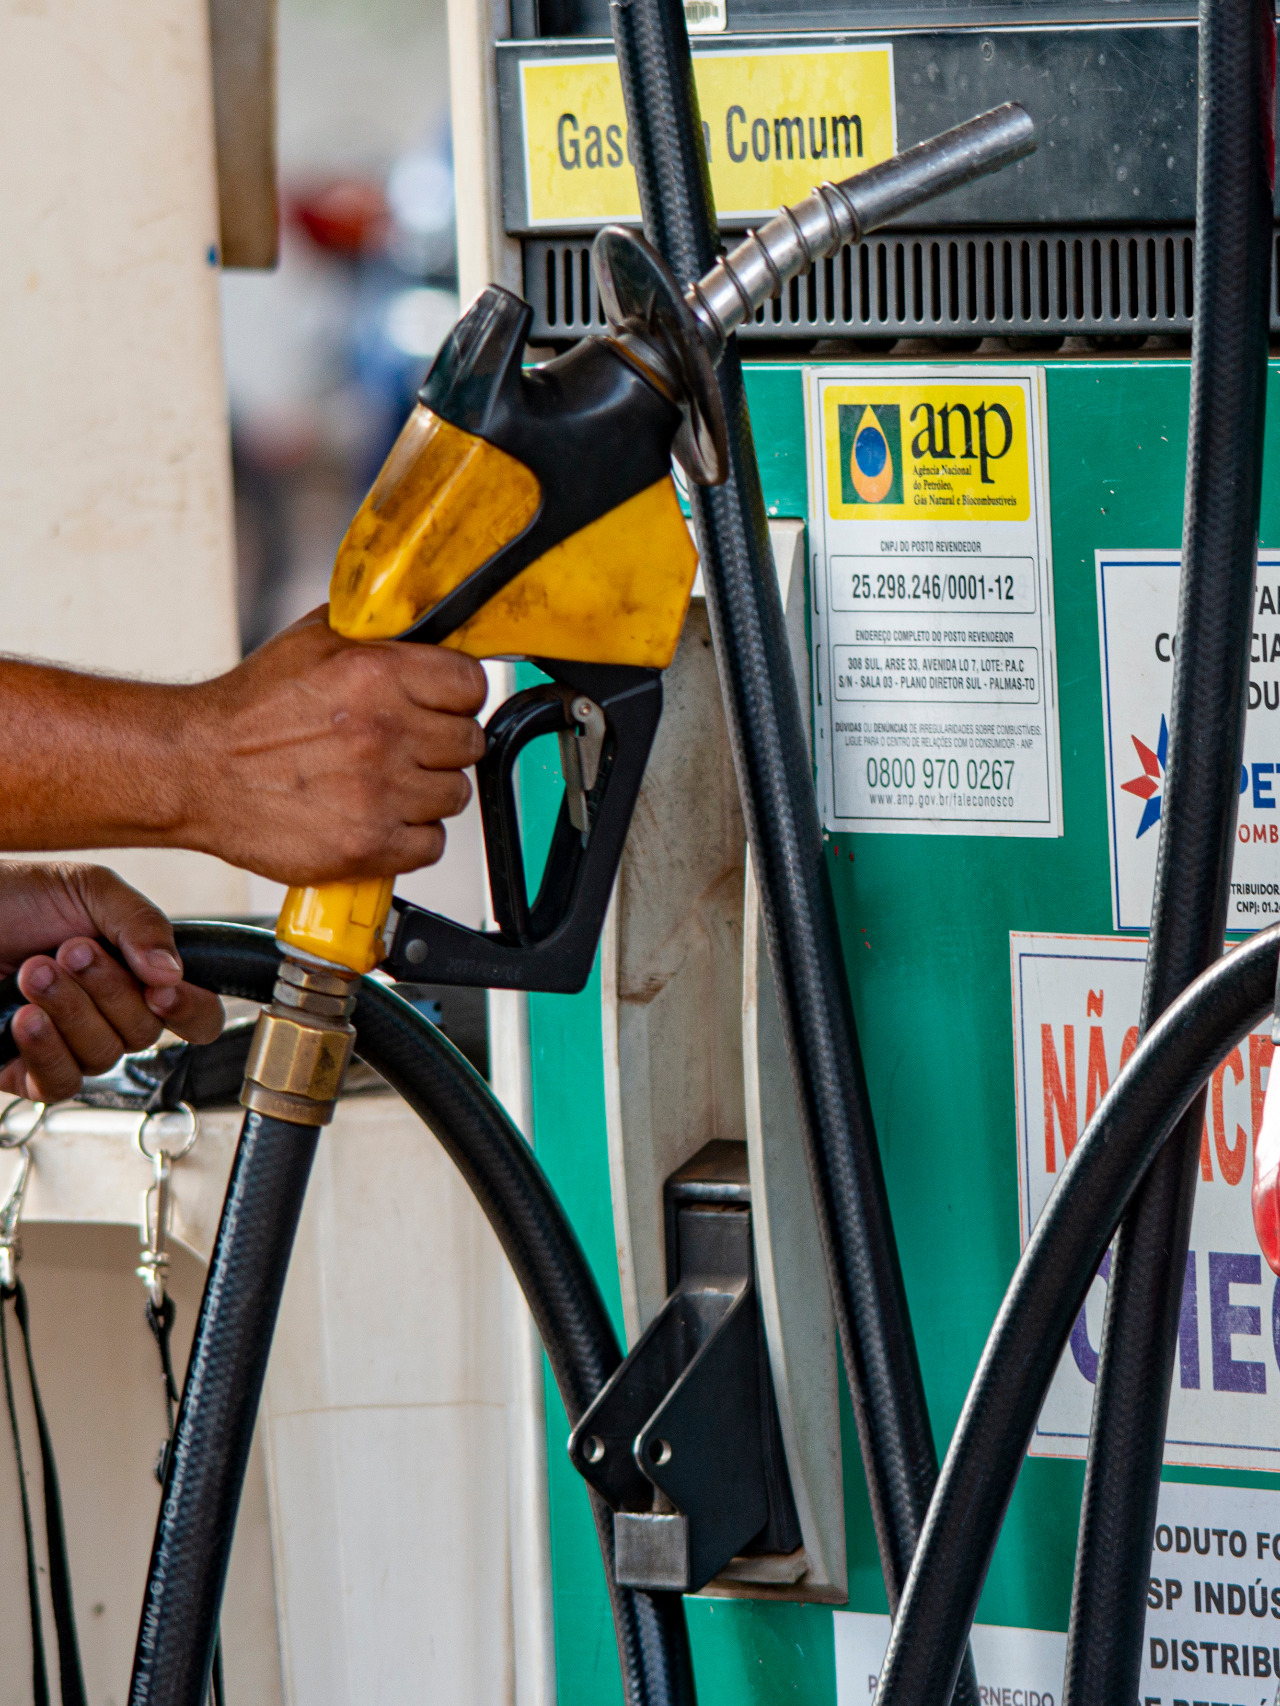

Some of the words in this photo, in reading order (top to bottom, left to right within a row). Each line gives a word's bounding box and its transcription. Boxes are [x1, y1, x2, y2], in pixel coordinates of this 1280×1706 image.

[726, 105, 864, 163] Comum
[910, 400, 1013, 484] anp
[913, 465, 939, 477] Agência
[941, 464, 972, 476] Nacional
[913, 480, 922, 490] do
[923, 480, 954, 492] Petróleo,
[929, 494, 955, 506] Natural
[880, 540, 898, 552] CNPJ
[900, 541, 909, 551] DO
[911, 541, 934, 552] POSTO
[936, 541, 982, 552] REVENDEDOR
[852, 573, 1015, 603] 25.298.246/0001-12
[855, 630, 892, 644] ENDEREÇO
[893, 630, 930, 642] COMPLETO
[932, 630, 942, 642] DO
[944, 631, 966, 642] POSTO
[968, 631, 1014, 643] REVENDEDOR
[865, 657, 882, 672] SUL,
[885, 658, 906, 671] ARSE
[922, 658, 957, 671] AVENIDA
[981, 659, 1003, 672] LOTE:
[838, 675, 853, 688] S/N
[860, 676, 881, 688] SALA
[883, 676, 893, 688] 03
[900, 676, 927, 689] PLANO
[929, 676, 964, 689] DIRETOR
[966, 677, 981, 690] SUL
[989, 677, 1035, 690] PALMAS-TO
[835, 721, 862, 733] DÚVIDAS
[873, 721, 908, 733] DENÚNCIAS
[909, 723, 917, 733] DE
[975, 724, 995, 735] SOBRE
[845, 736, 862, 746] LIGUE
[863, 736, 879, 747] PARA
[887, 736, 910, 747] CENTRO
[912, 737, 920, 747] DE
[954, 738, 967, 748] COM
[975, 738, 1016, 749] CONSUMIDOR
[867, 757, 916, 788] 0800
[922, 758, 959, 789] 970
[966, 758, 1015, 790] 0267
[869, 793, 1015, 809] www.anp.gov.br/faleconosco
[1236, 901, 1260, 915] CNPJ:
[1154, 1524, 1247, 1558] ODUTO
